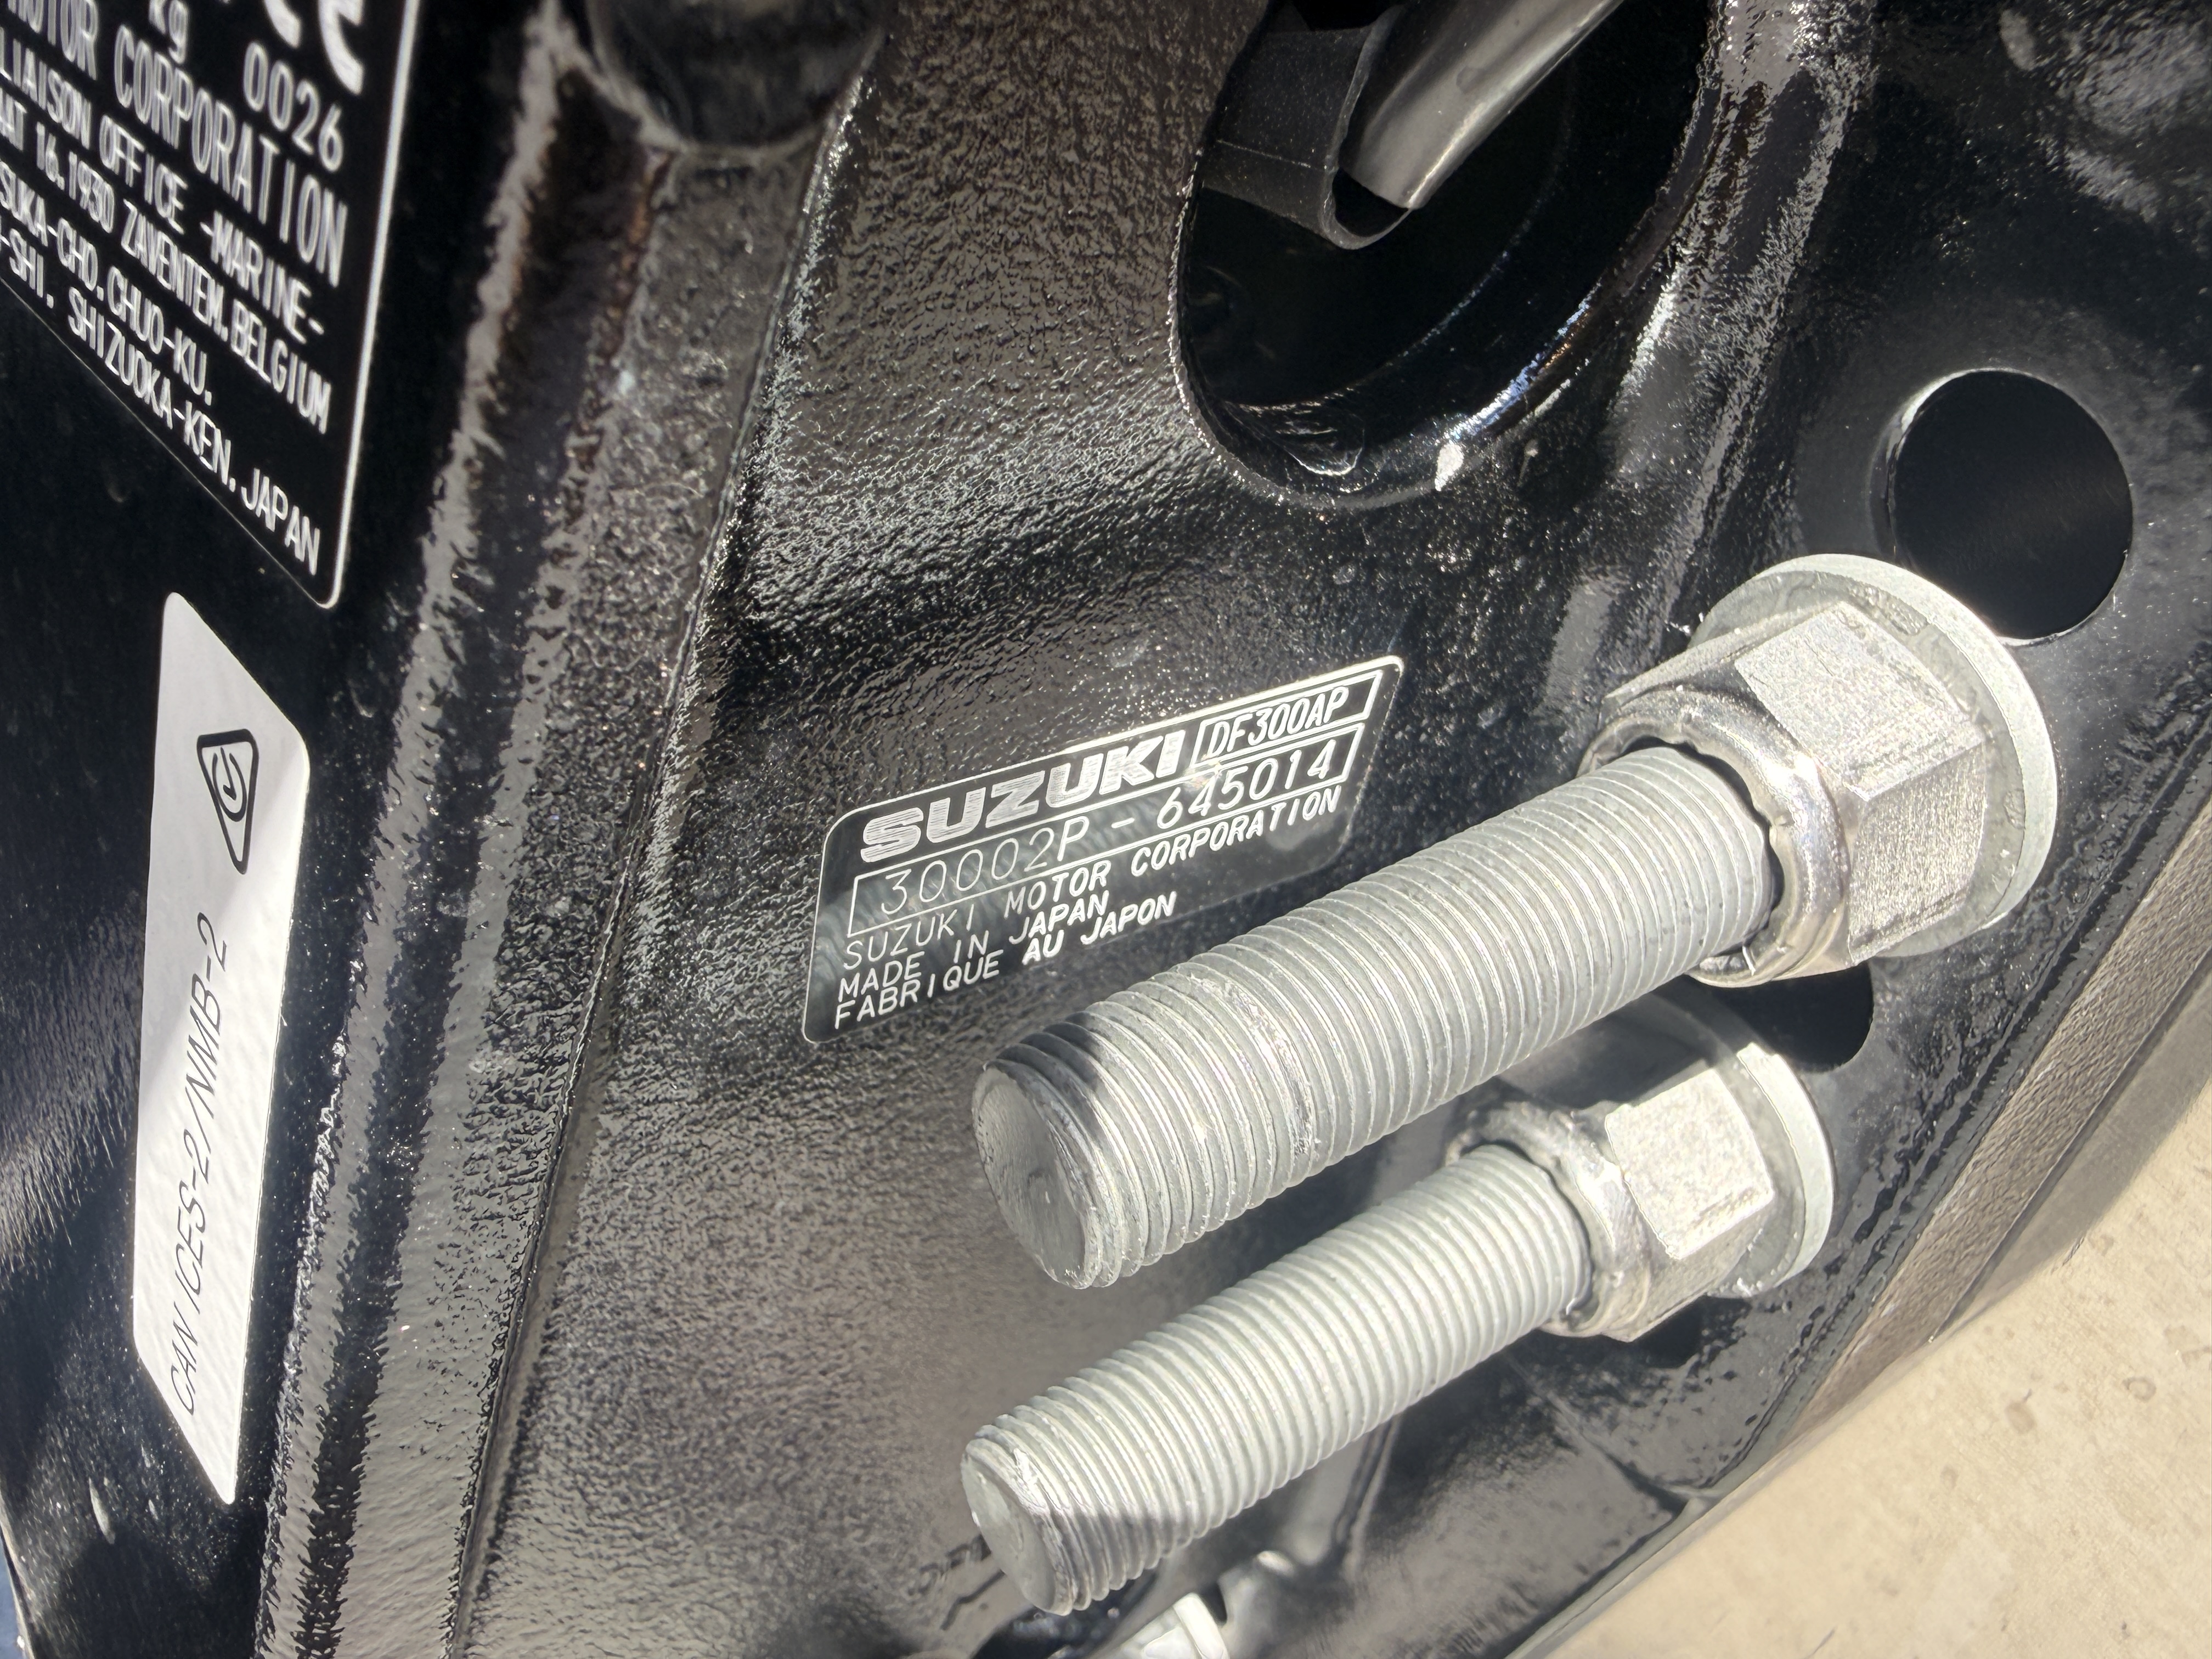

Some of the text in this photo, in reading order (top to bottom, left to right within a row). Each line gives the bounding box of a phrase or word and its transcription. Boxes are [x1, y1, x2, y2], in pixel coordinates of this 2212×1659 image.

[99, 115, 188, 235] OFFICE
[114, 24, 348, 287] CORPORATION
[243, 41, 344, 172] 0026
[241, 467, 320, 575] JAPAN
[860, 686, 1349, 863] SUZUKI DF300AP
[881, 815, 1090, 915] 30002P
[1157, 739, 1337, 830] 645014
[838, 890, 1109, 1002] MADE IN JAPAN
[843, 785, 1342, 970] SUZUKI MOTOR CORPORATION
[834, 891, 1177, 1030] FABRIQUE AU JAPON
[171, 911, 227, 1416] CAN ICES-2/NMB-2
